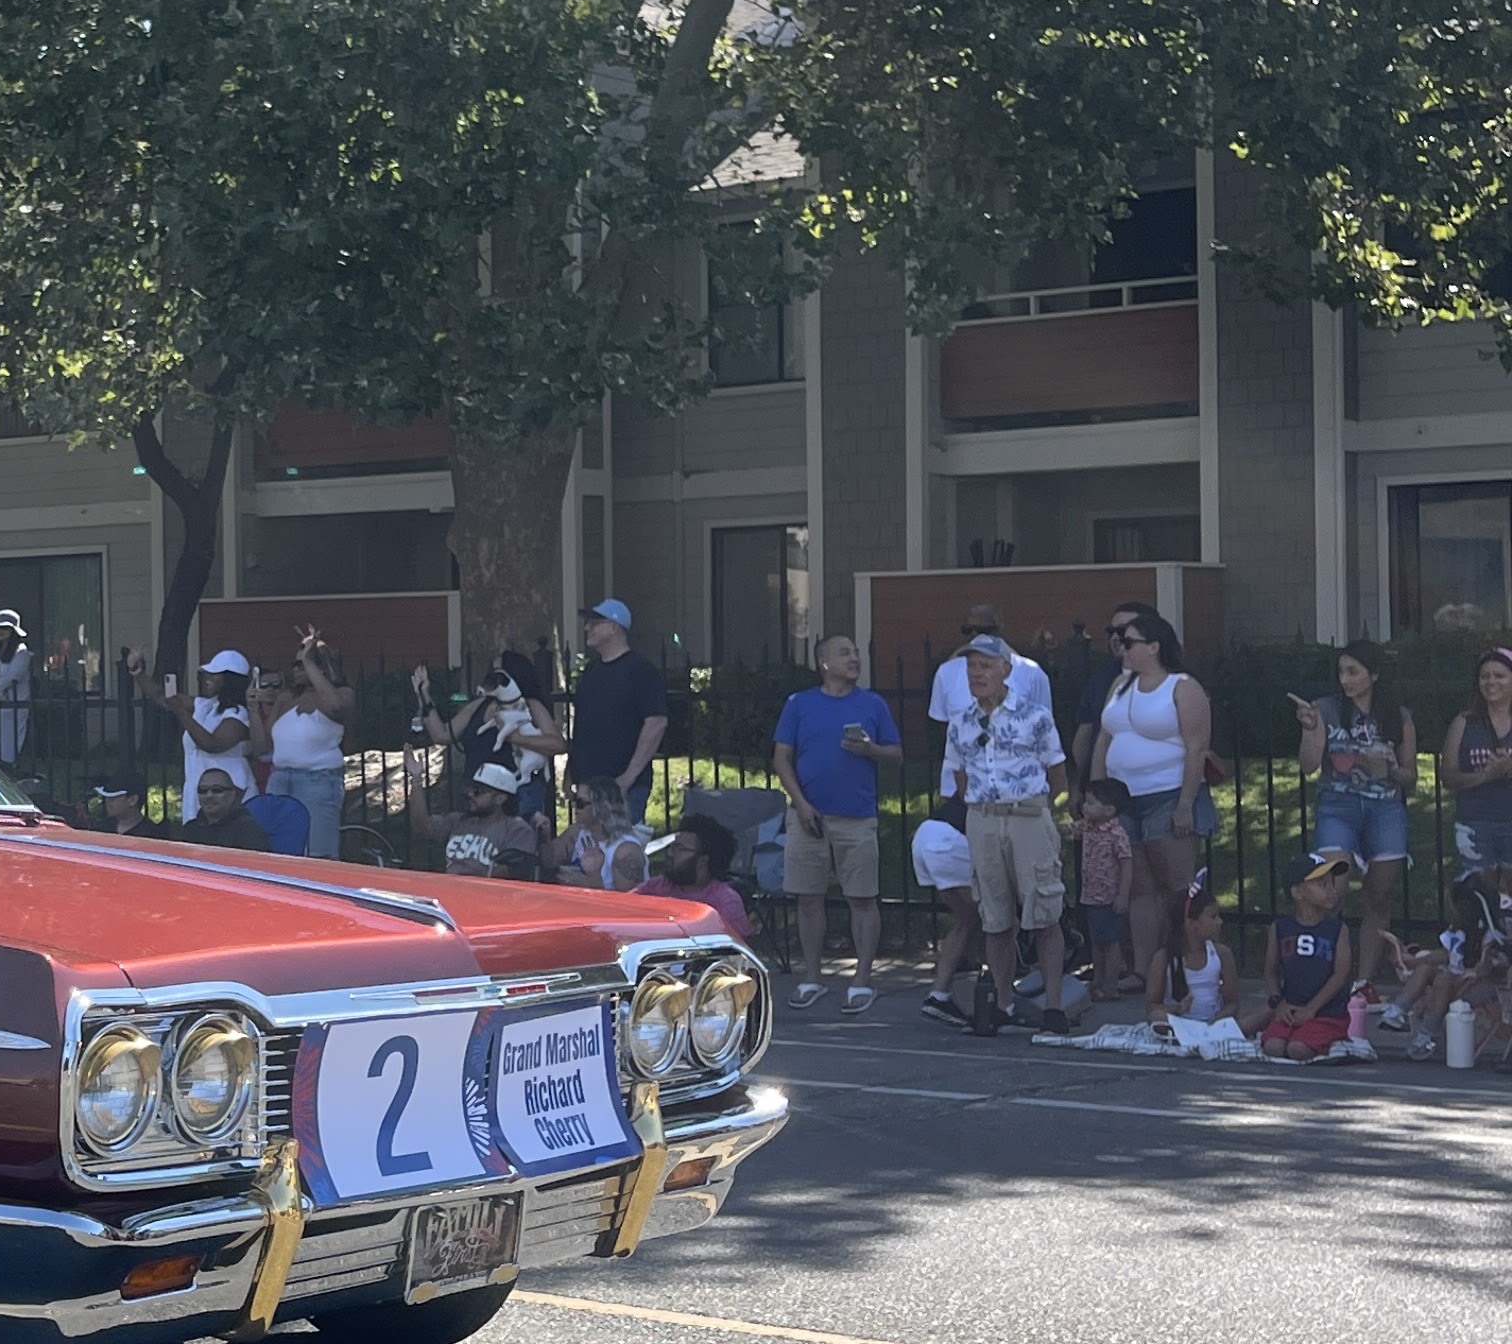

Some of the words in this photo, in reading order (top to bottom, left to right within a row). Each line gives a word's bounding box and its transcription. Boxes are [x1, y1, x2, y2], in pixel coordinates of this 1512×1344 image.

[503, 1033, 543, 1076] Grand
[545, 1024, 601, 1065] Marshal
[367, 1034, 433, 1177] 2
[524, 1069, 586, 1116] Richard
[534, 1112, 595, 1151] Cherry
[424, 1200, 506, 1258] FAMILY
